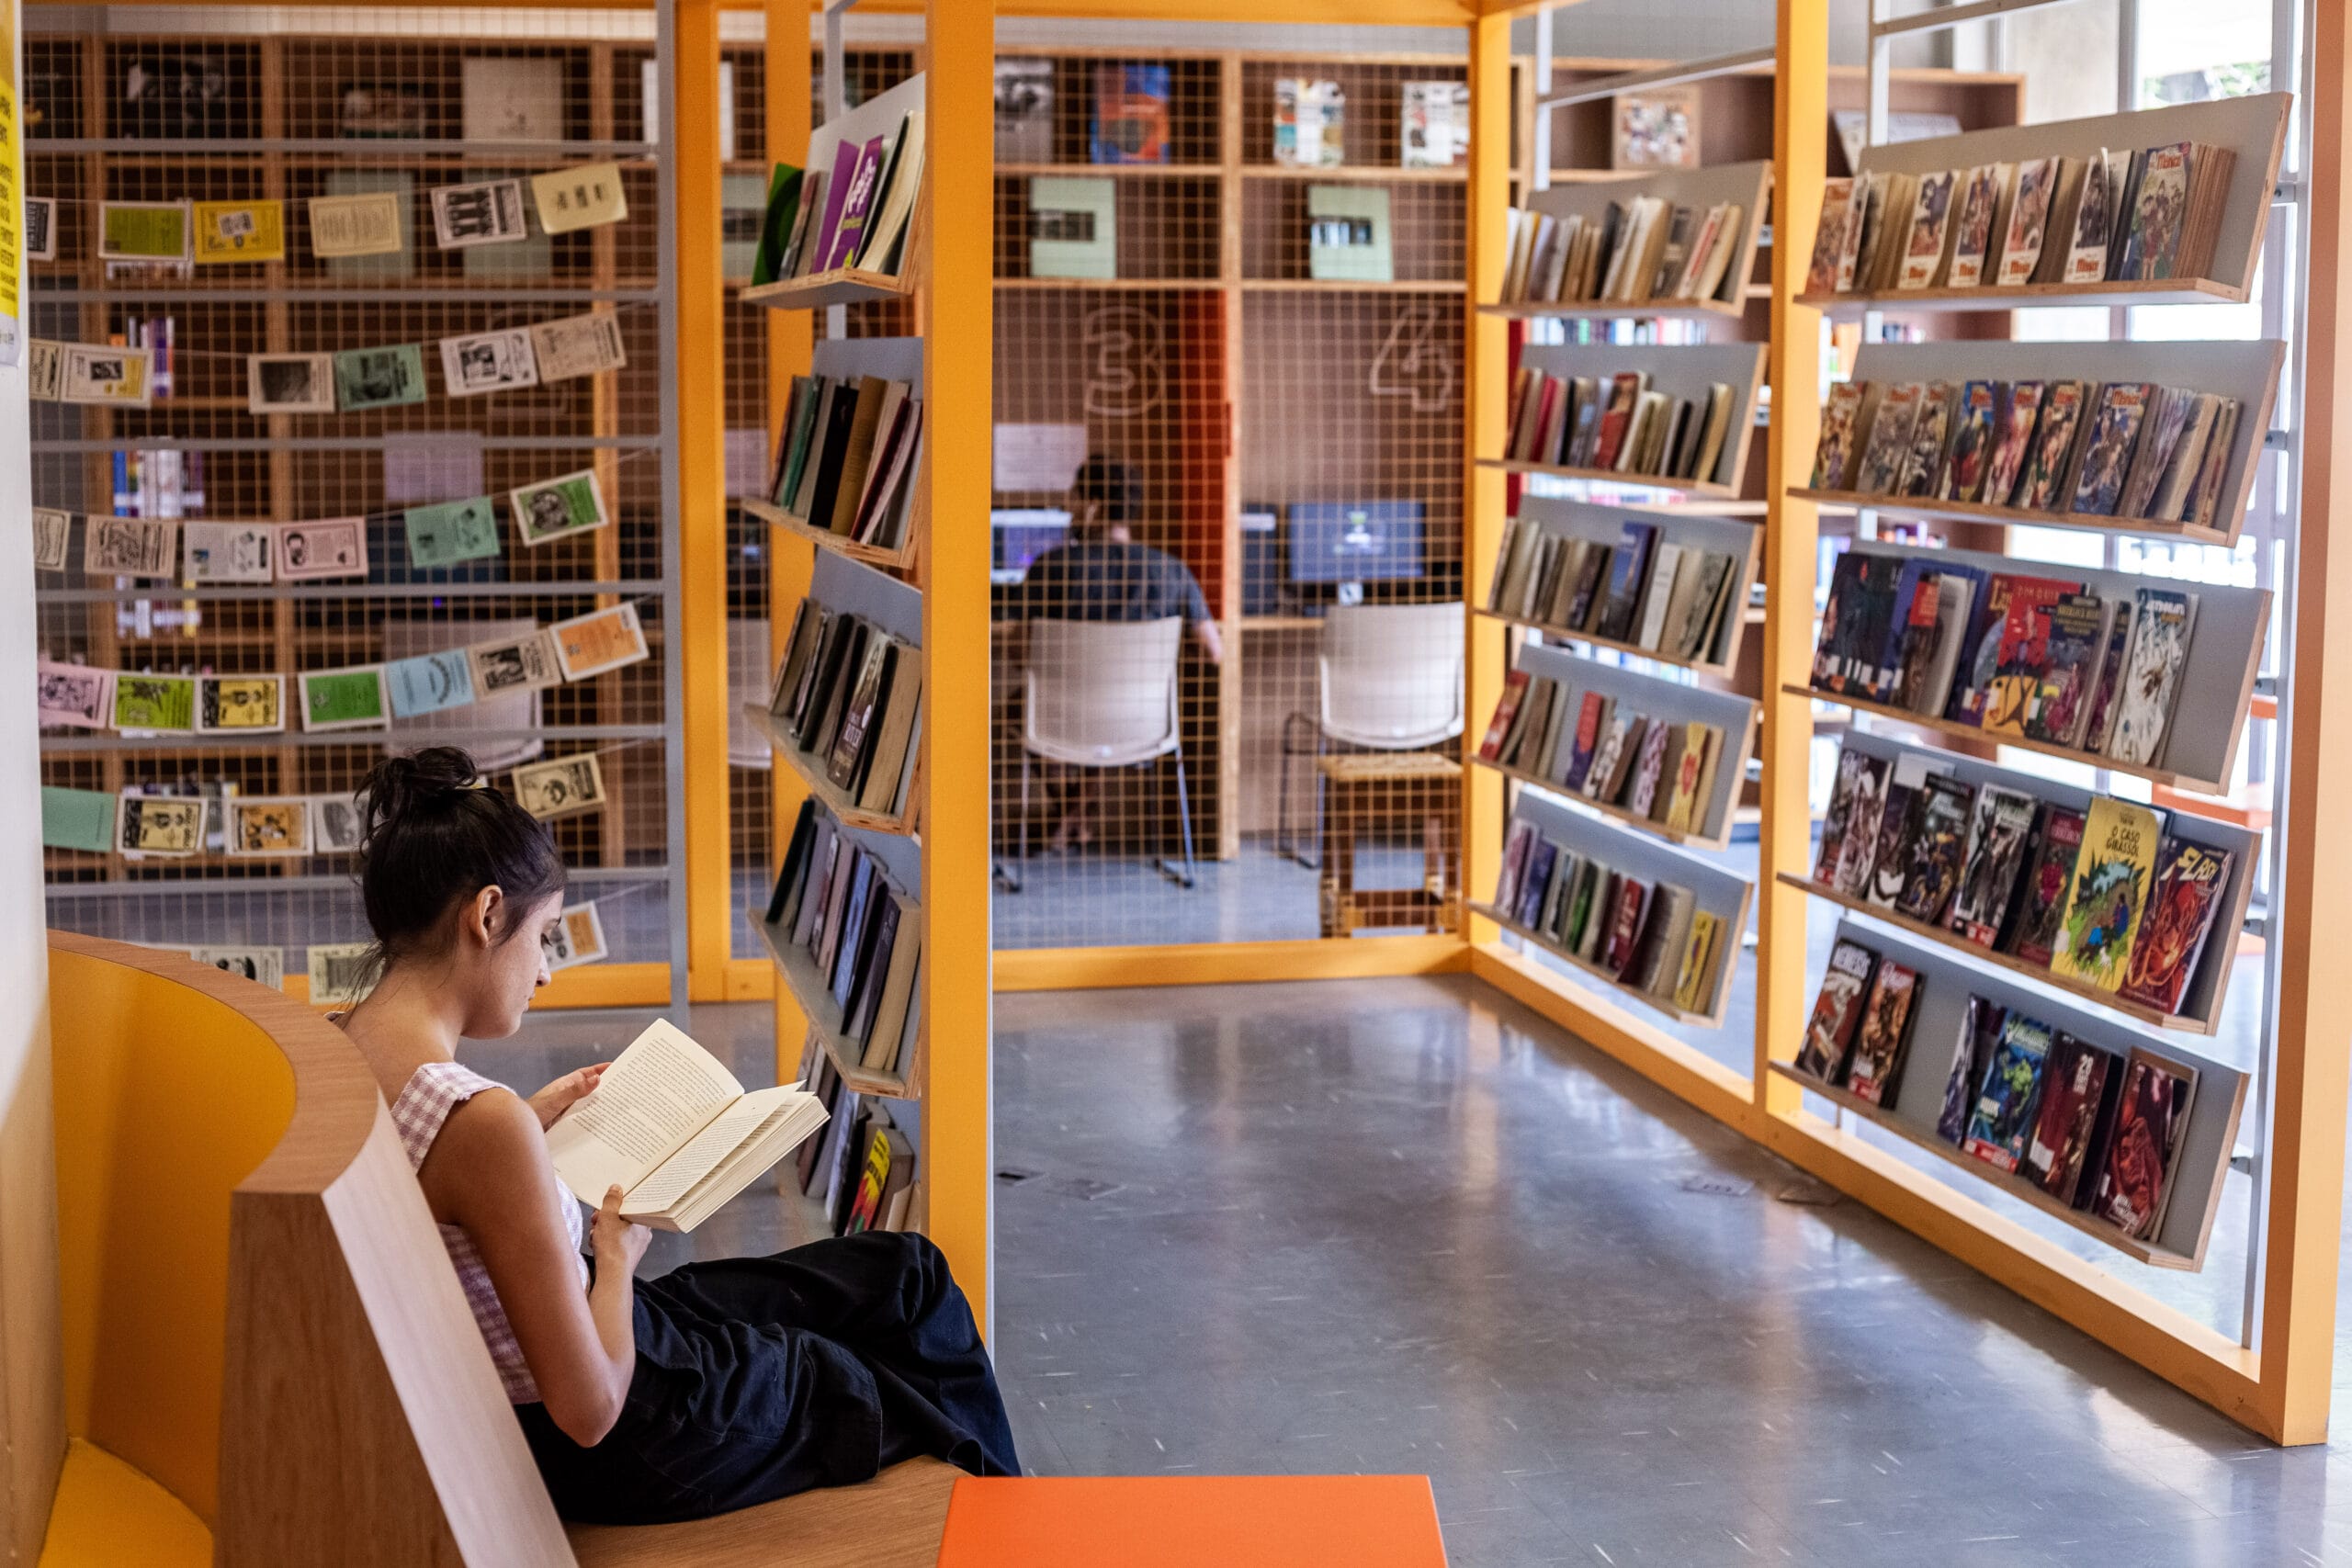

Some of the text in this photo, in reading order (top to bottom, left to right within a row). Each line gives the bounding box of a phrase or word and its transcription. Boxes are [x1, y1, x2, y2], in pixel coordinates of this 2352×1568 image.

[1084, 305, 1166, 416] 3
[1369, 307, 1453, 412] 4
[2106, 837, 2140, 856] GIRASSOL
[2120, 828, 2141, 842] CASO
